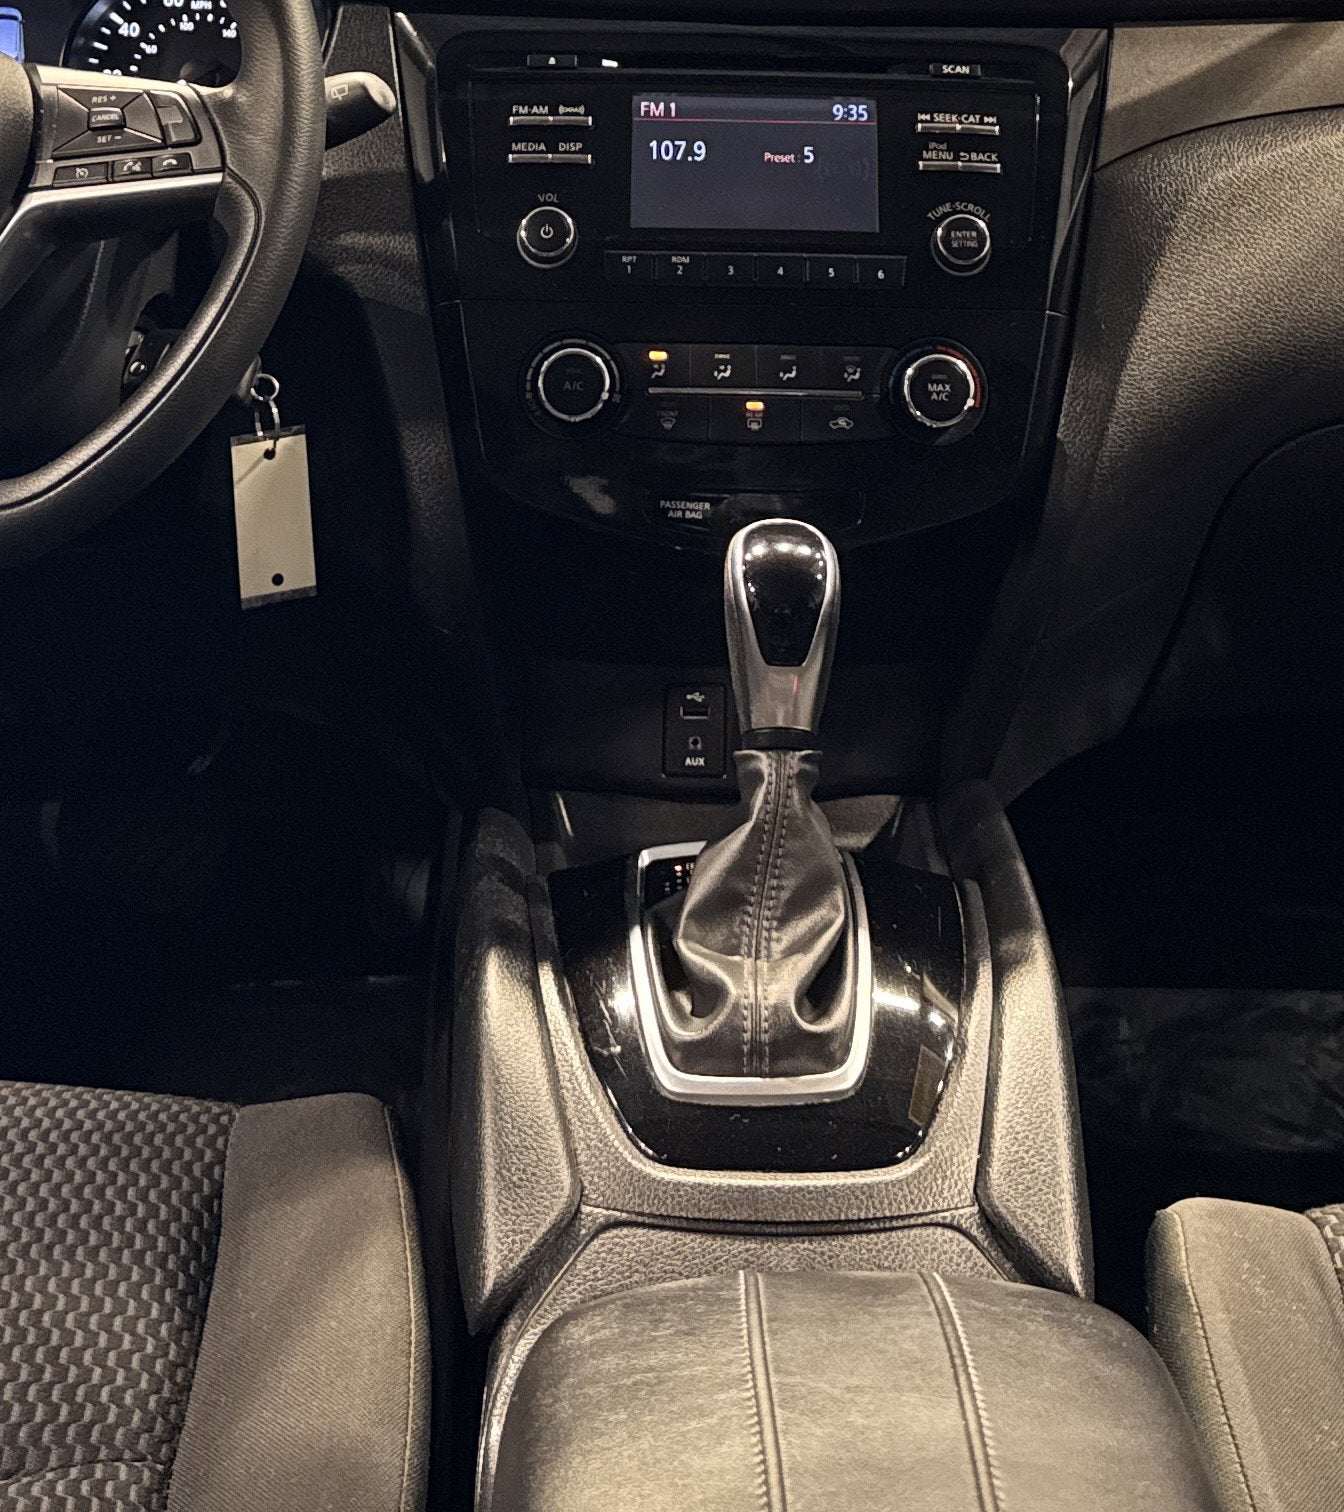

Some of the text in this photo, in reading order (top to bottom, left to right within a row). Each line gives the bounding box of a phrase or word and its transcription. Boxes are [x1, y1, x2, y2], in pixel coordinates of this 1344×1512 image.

[190, 0, 212, 10] MPH
[118, 21, 141, 37] 40
[941, 65, 970, 75] SCAN
[91, 94, 108, 104] RES
[640, 101, 676, 118] FM 1
[832, 103, 868, 122] 9:35
[91, 113, 120, 123] CANCEL
[96, 134, 113, 144] SET
[511, 141, 547, 152] MEDIA
[558, 141, 583, 153] DISP
[649, 140, 707, 162] 107.9
[928, 141, 947, 150] iPod
[803, 146, 815, 164] 5
[922, 150, 954, 161] MENU
[970, 151, 999, 162] BACK
[537, 192, 560, 203] VOL
[950, 230, 977, 239] ENTER
[626, 265, 632, 275] 1
[676, 265, 683, 275] 2
[727, 266, 735, 276] 3
[777, 266, 784, 276] 4
[828, 267, 835, 278] 5
[877, 269, 885, 279] 6
[563, 380, 584, 391] A/C
[927, 383, 951, 393] MAX
[930, 392, 950, 402] A/C
[659, 499, 711, 510] PASSENGER
[667, 509, 704, 520] AIR BAG
[684, 756, 706, 767] AUX
